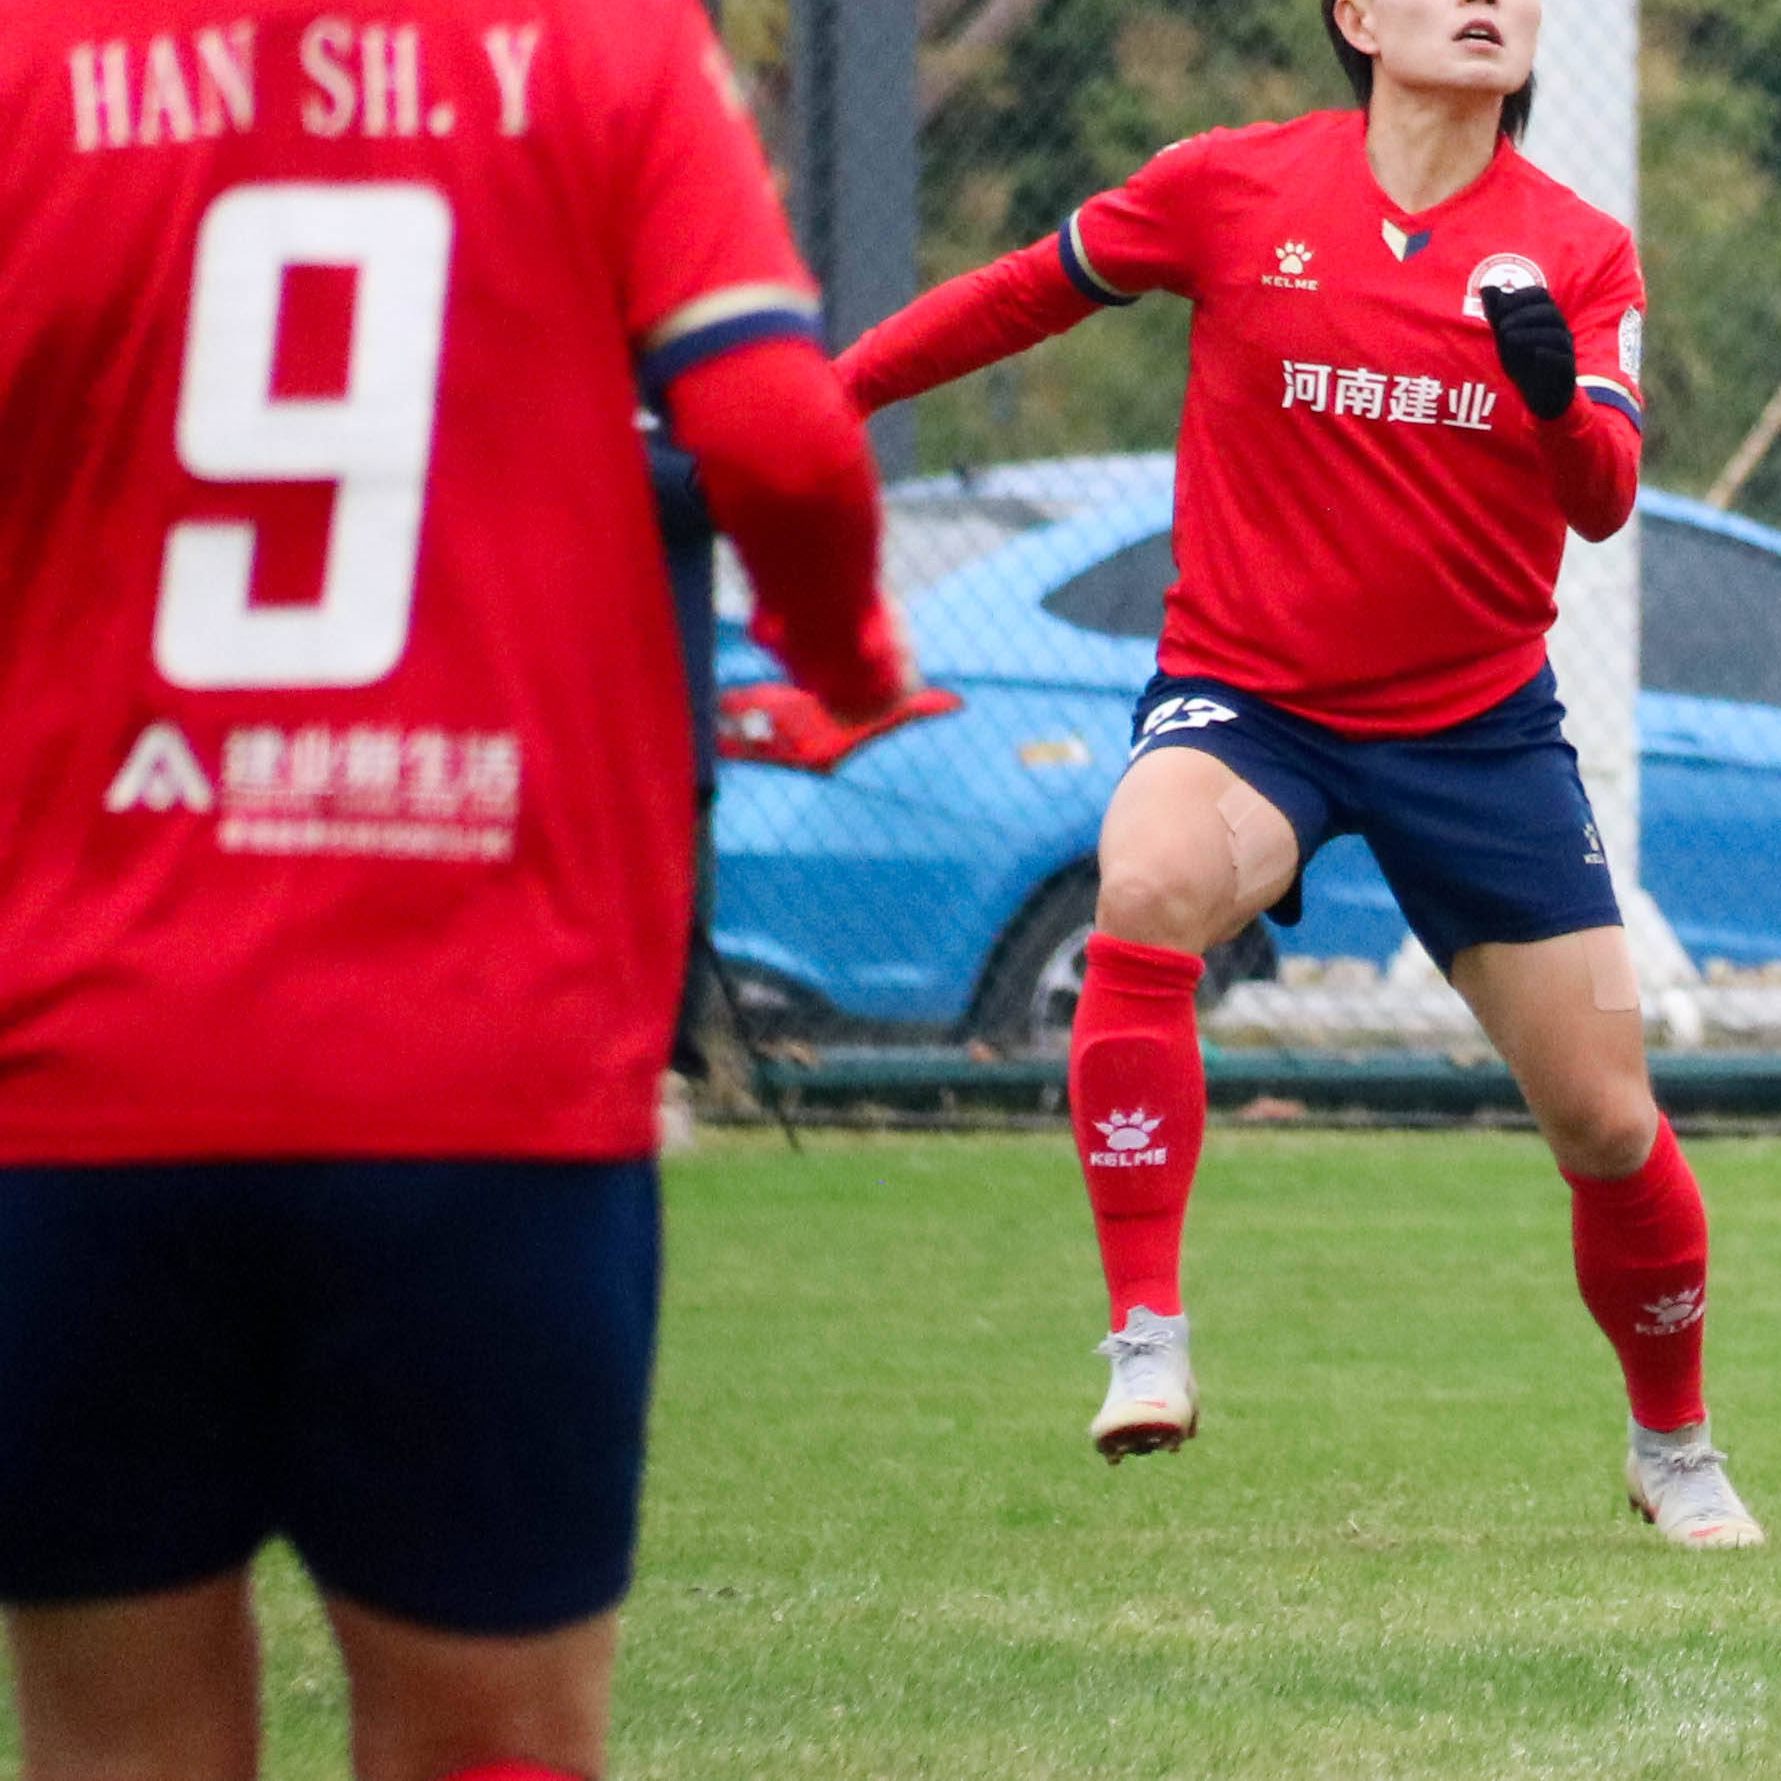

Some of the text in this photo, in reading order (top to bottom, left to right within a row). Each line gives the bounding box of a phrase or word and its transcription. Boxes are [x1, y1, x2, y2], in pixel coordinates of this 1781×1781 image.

[69, 21, 257, 152] HAN
[1261, 274, 1319, 290] KELME
[1281, 360, 1497, 431] 河南建业
[153, 180, 454, 691] 9
[1090, 1147, 1167, 1167] KELME
